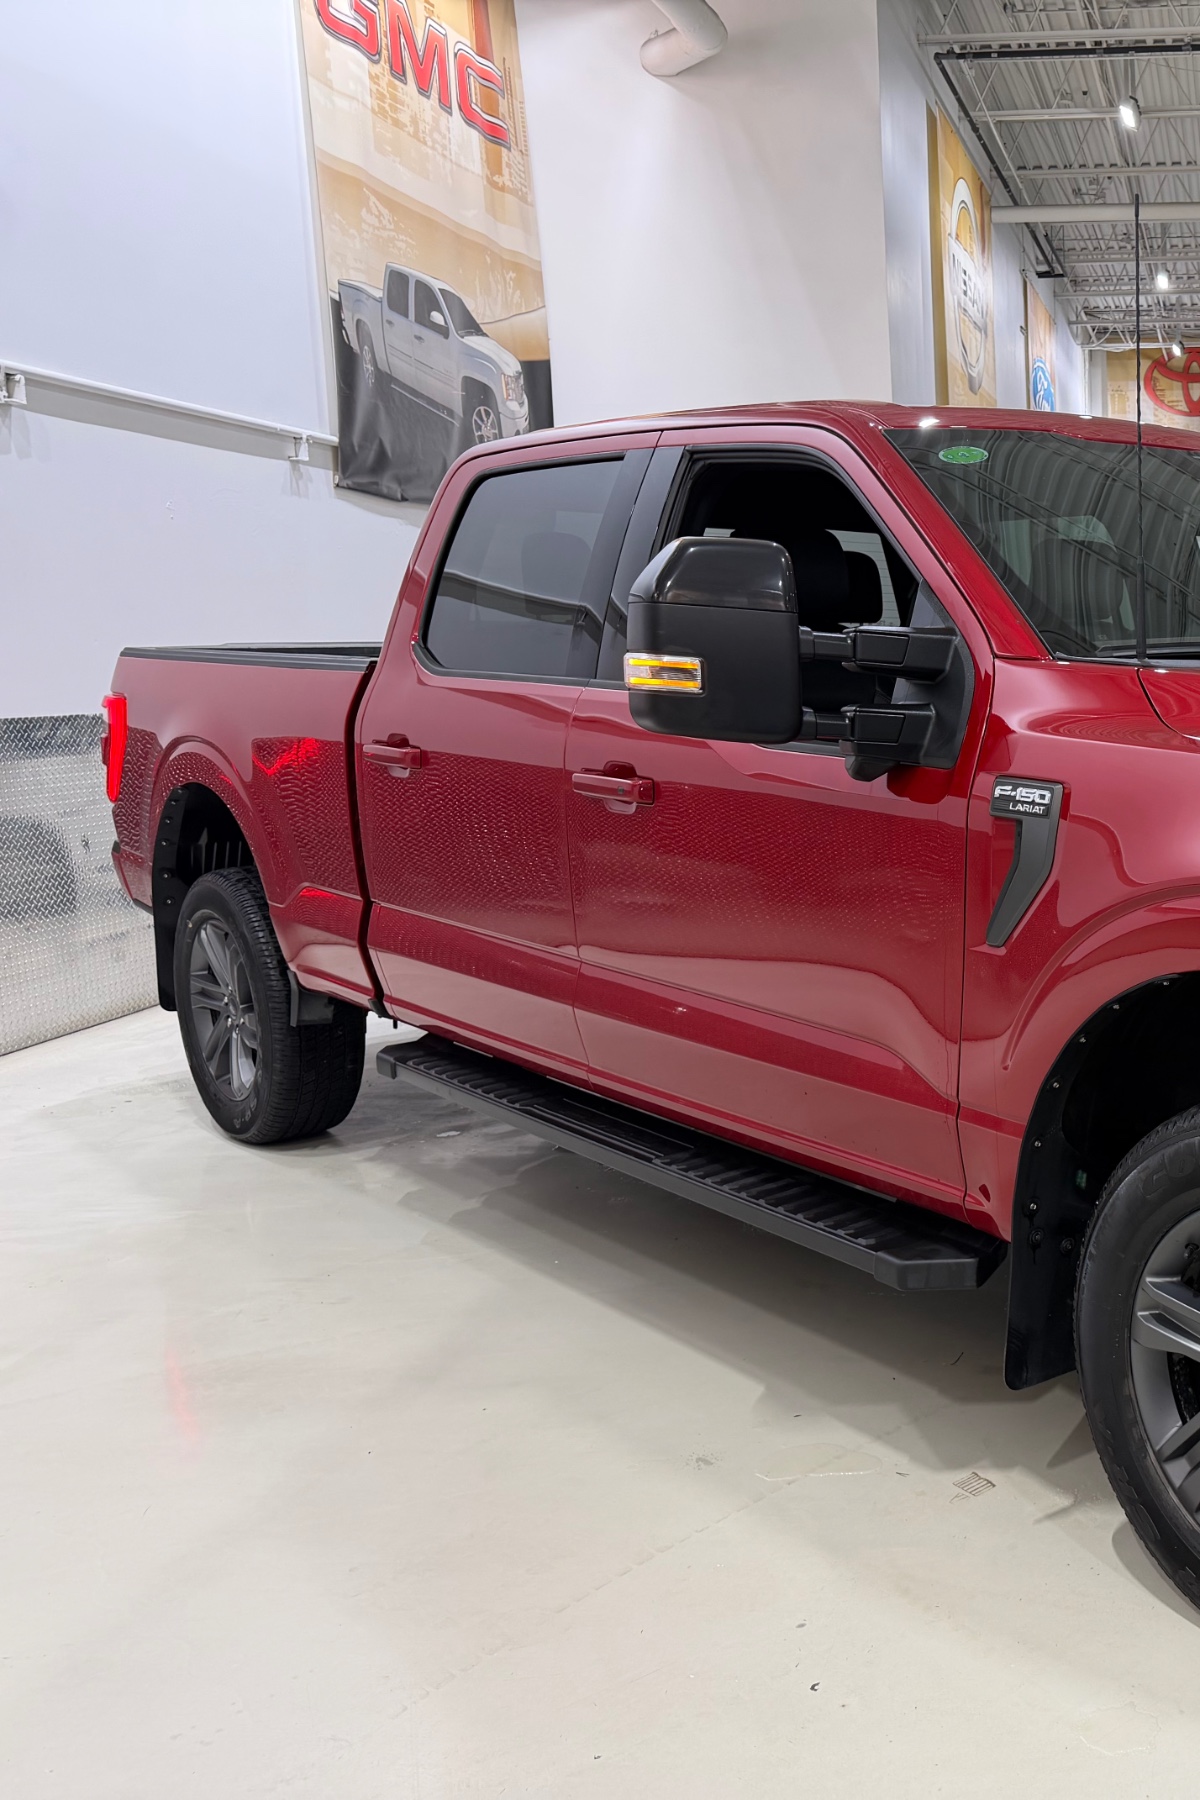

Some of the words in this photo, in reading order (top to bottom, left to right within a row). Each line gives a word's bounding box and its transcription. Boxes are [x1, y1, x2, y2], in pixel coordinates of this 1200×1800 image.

[314, 0, 511, 152] GMC
[993, 785, 1052, 805] F-150
[1009, 802, 1046, 814] LARIAT
